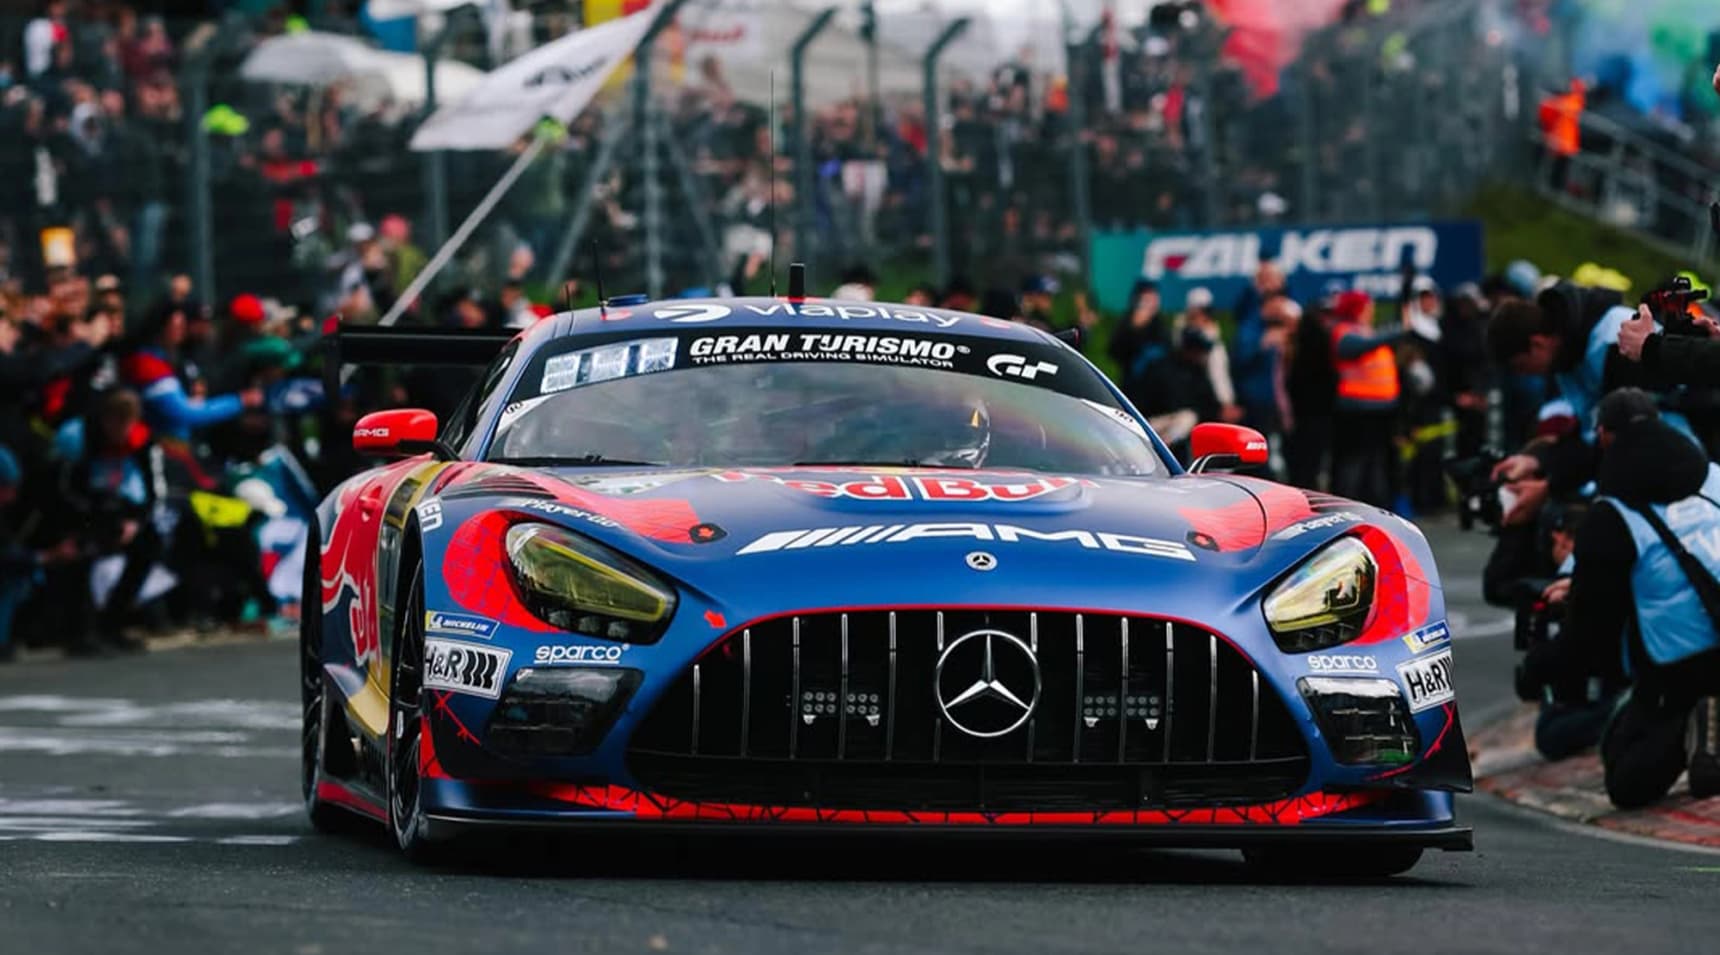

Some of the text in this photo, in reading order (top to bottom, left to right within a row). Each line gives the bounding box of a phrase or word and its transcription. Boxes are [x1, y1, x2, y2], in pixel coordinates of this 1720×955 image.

[1142, 226, 1437, 278] FALKEN
[690, 334, 790, 356] GRAN
[692, 351, 953, 368] THE REAL DRIVING SIMULATOR
[886, 522, 1197, 562] AMG
[533, 645, 622, 665] sparco
[1307, 654, 1378, 674] sparco
[1404, 663, 1447, 700] H&R
